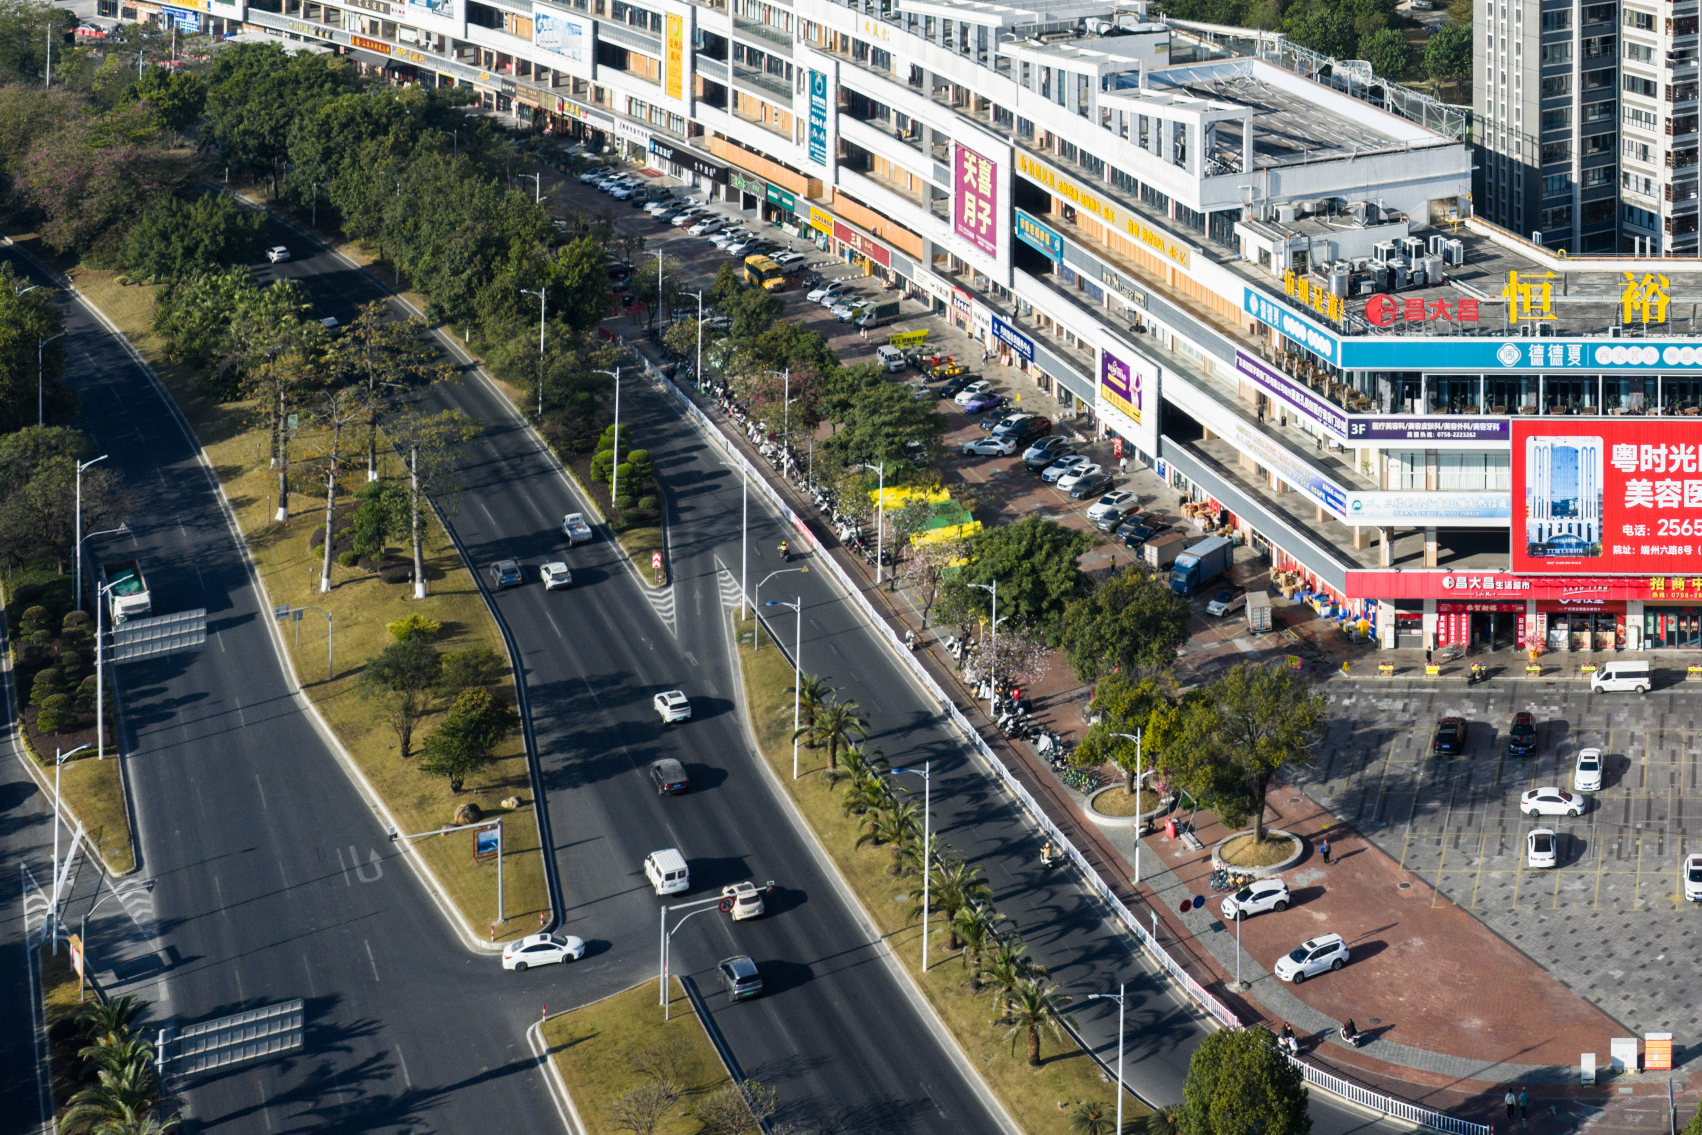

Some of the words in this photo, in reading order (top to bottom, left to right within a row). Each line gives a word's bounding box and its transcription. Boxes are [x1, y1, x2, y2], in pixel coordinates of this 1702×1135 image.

[1284, 267, 1338, 322] 佰创足道
[1404, 298, 1479, 321] 昌大昌
[1528, 344, 1583, 367] 德德夏
[1351, 423, 1366, 435] 3F
